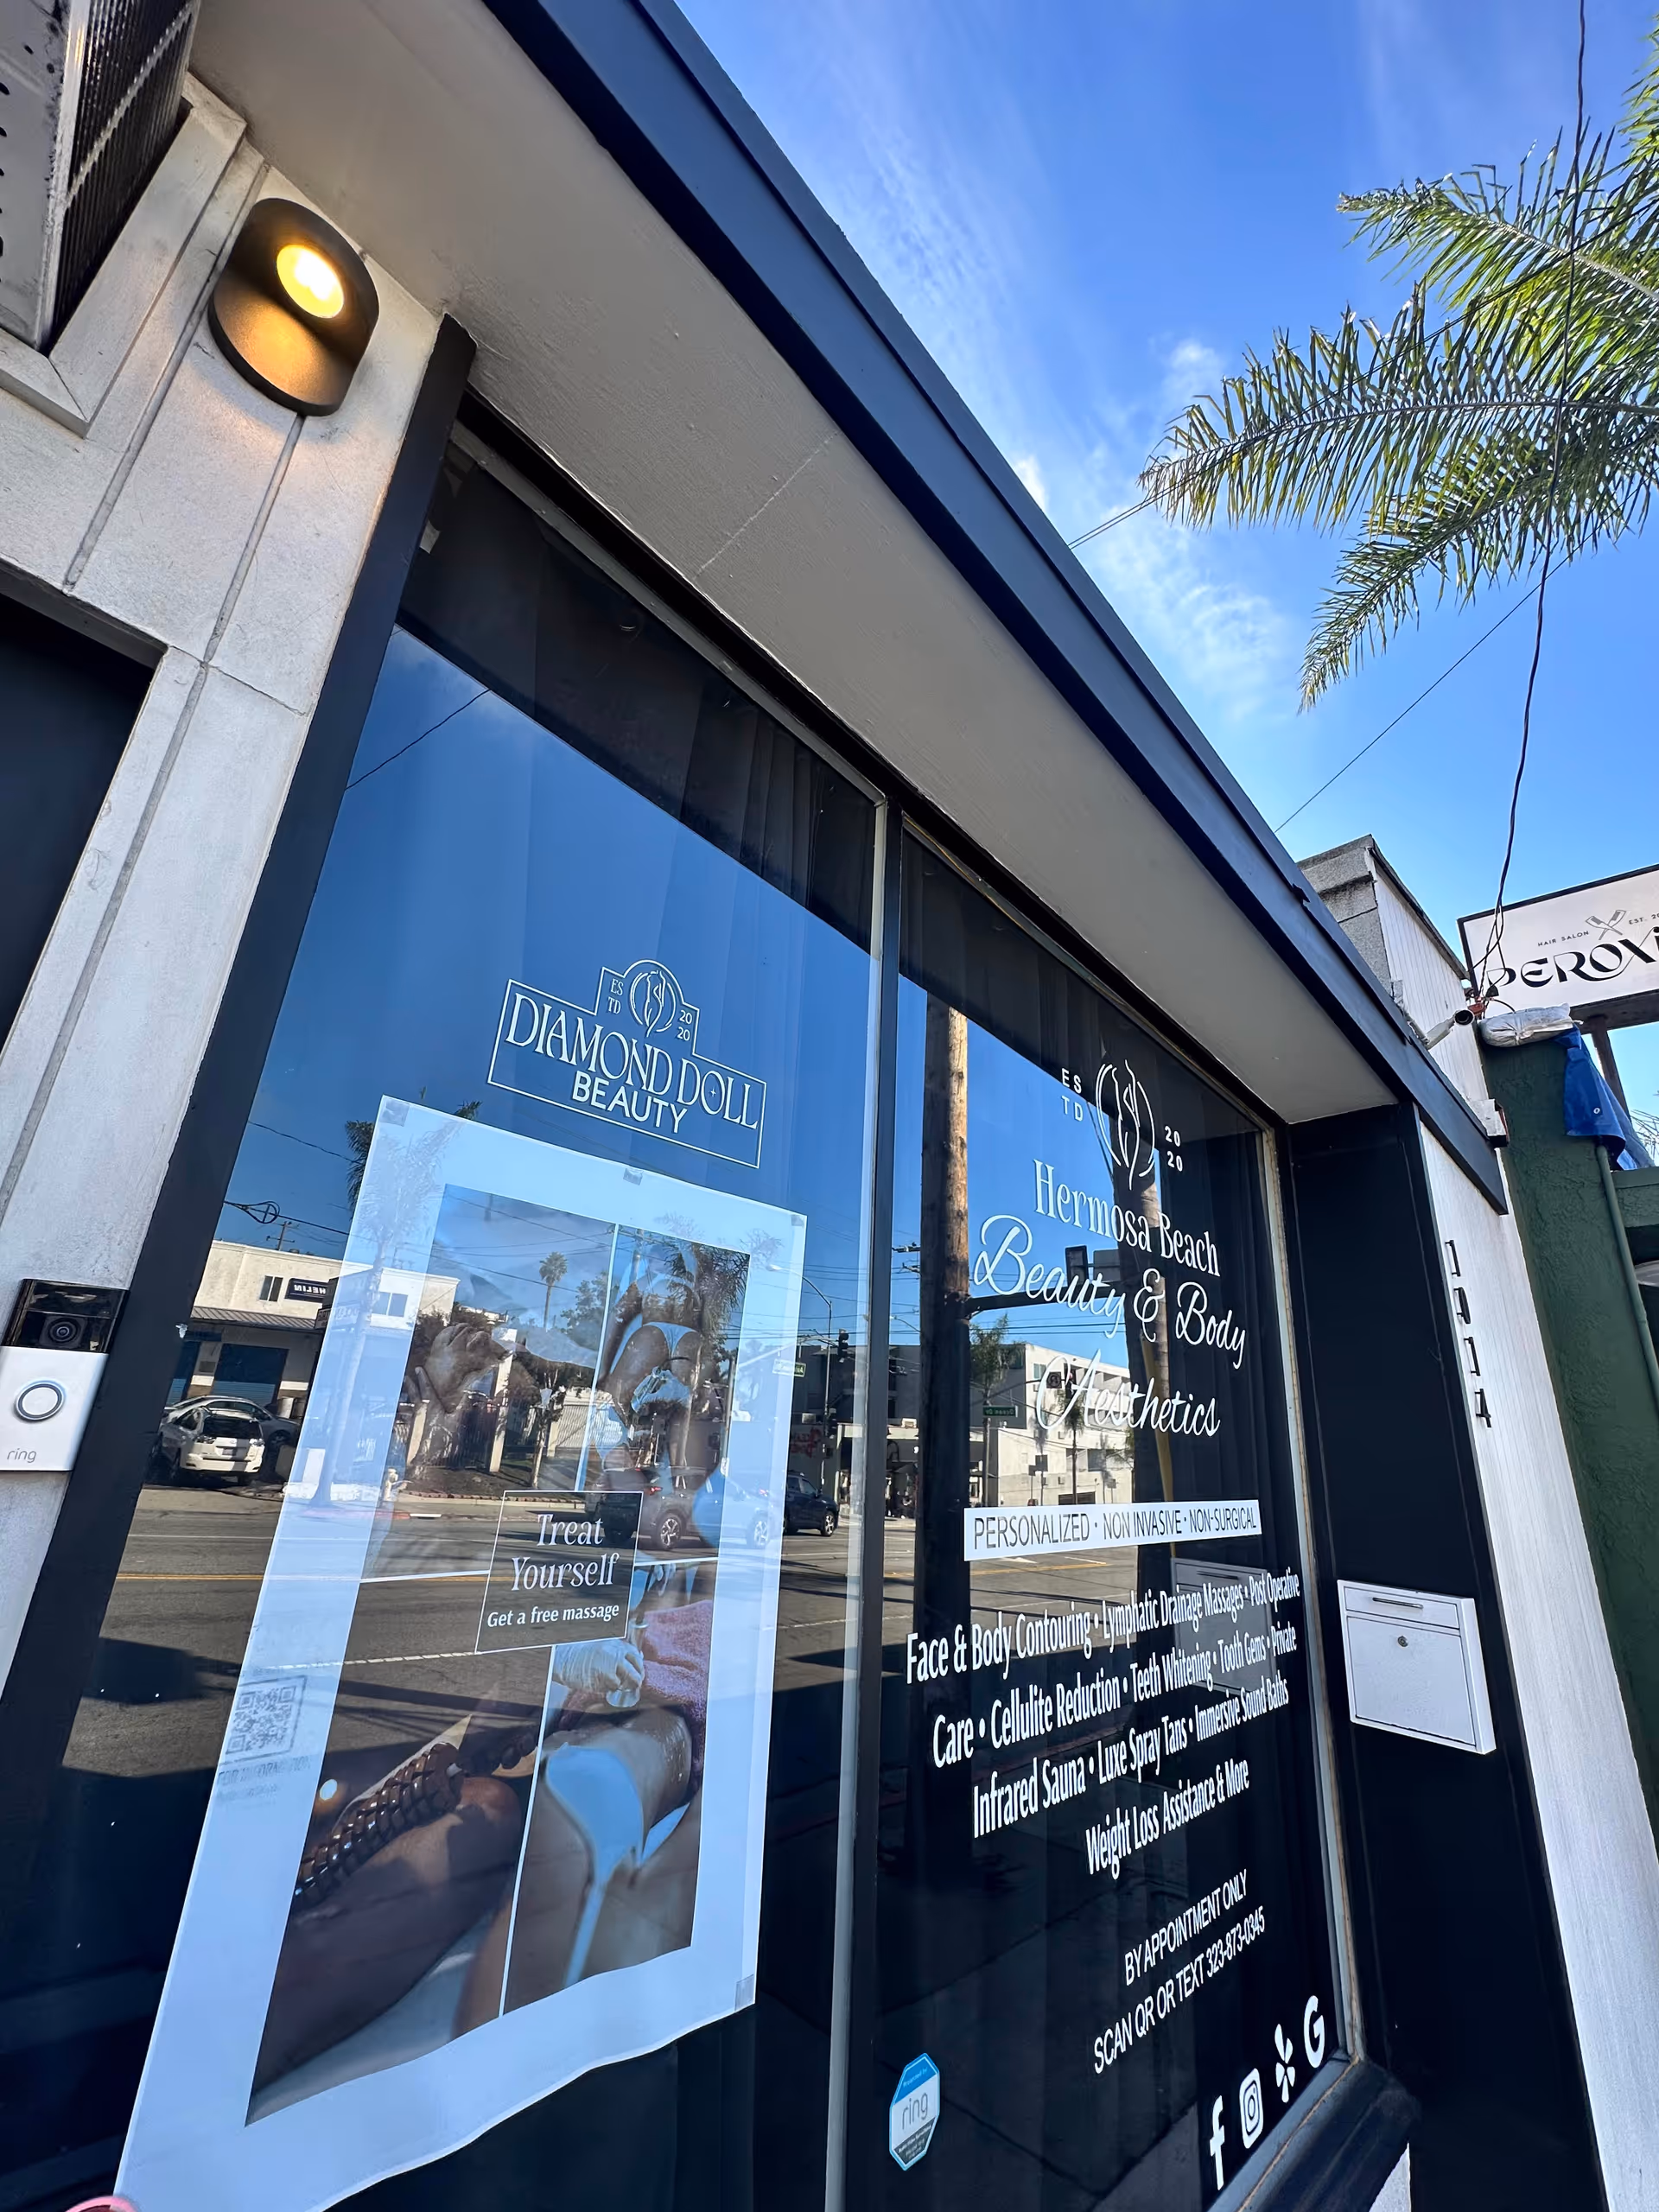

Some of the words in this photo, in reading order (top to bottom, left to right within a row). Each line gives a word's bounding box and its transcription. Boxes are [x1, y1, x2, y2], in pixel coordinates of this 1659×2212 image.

[1538, 938, 1557, 947] HAIR
[1561, 931, 1589, 942] SALON
[607, 996, 621, 1015] TD
[610, 978, 624, 996] ES
[677, 1026, 690, 1042] 20
[678, 1009, 692, 1025] 20
[505, 993, 673, 1096] DIAMOND
[677, 1058, 759, 1130] DOLL
[1061, 1068, 1082, 1094] ES
[572, 1070, 688, 1135] BEAUTY
[1061, 1096, 1084, 1122] TD
[1165, 1125, 1181, 1147] 20
[1166, 1150, 1183, 1173] 20
[1033, 1159, 1153, 1253] Hermosa
[1158, 1211, 1220, 1278] Beach
[974, 1215, 1127, 1338] Beauty
[1133, 1268, 1166, 1342] &
[1175, 1281, 1246, 1370] Body
[1036, 1349, 1221, 1436] Aesthetics
[7, 1448, 37, 1463] ring
[537, 1514, 603, 1546] Treat
[974, 1513, 1090, 1550] PERSONALIZED
[1103, 1512, 1130, 1541] NON
[1133, 1509, 1182, 1538] INVASIVE
[1189, 1507, 1256, 1533] NON-SURGICAL
[512, 1552, 620, 1591] Yourself
[487, 1610, 512, 1627] Get
[517, 1611, 526, 1625] a
[531, 1605, 559, 1624] free
[563, 1604, 620, 1622] massage
[906, 1632, 949, 1684] Face
[954, 1624, 967, 1673] &
[972, 1611, 1012, 1680] Body
[1016, 1601, 1092, 1660] Contouring
[1102, 1590, 1160, 1653] Lymphatic
[1160, 1581, 1203, 1632] Drainage
[1204, 1582, 1244, 1624] Massages
[1249, 1573, 1266, 1607] Post
[1266, 1566, 1300, 1604] Operative
[933, 1714, 975, 1768] Care
[991, 1688, 1053, 1750] Cellulite
[1056, 1672, 1121, 1727] Reduction
[1129, 1655, 1161, 1703] Teeth
[1161, 1642, 1211, 1694] Whitening
[1217, 1637, 1243, 1675] Tooth
[1243, 1634, 1266, 1665] Gems
[1270, 1620, 1296, 1657] Private
[973, 1758, 1039, 1838] Infrared
[1042, 1756, 1086, 1808] Sauna
[1097, 1738, 1128, 1785] Luxe
[1128, 1726, 1161, 1783] Spray
[1161, 1714, 1187, 1756] Tans
[1194, 1692, 1240, 1742] Immersive
[1240, 1677, 1267, 1722] Sound
[1266, 1669, 1289, 1715] Baths
[1085, 1806, 1131, 1879] Weight
[1133, 1802, 1160, 1849] Loss
[1162, 1775, 1216, 1834] Assistance
[1216, 1768, 1225, 1802] &
[1225, 1758, 1249, 1797] More
[1125, 1945, 1143, 1986] BY
[1144, 1887, 1221, 1974] APPOINTMENT
[1223, 1869, 1248, 1910] ONLY
[1094, 2012, 1133, 2075] SCAN
[1135, 1996, 1156, 2037] QR
[1157, 1978, 1177, 2019] OR
[1176, 1953, 1205, 2003] TEXT
[1206, 1905, 1265, 1978] 323-873-0345
[901, 2092, 929, 2130] ring
